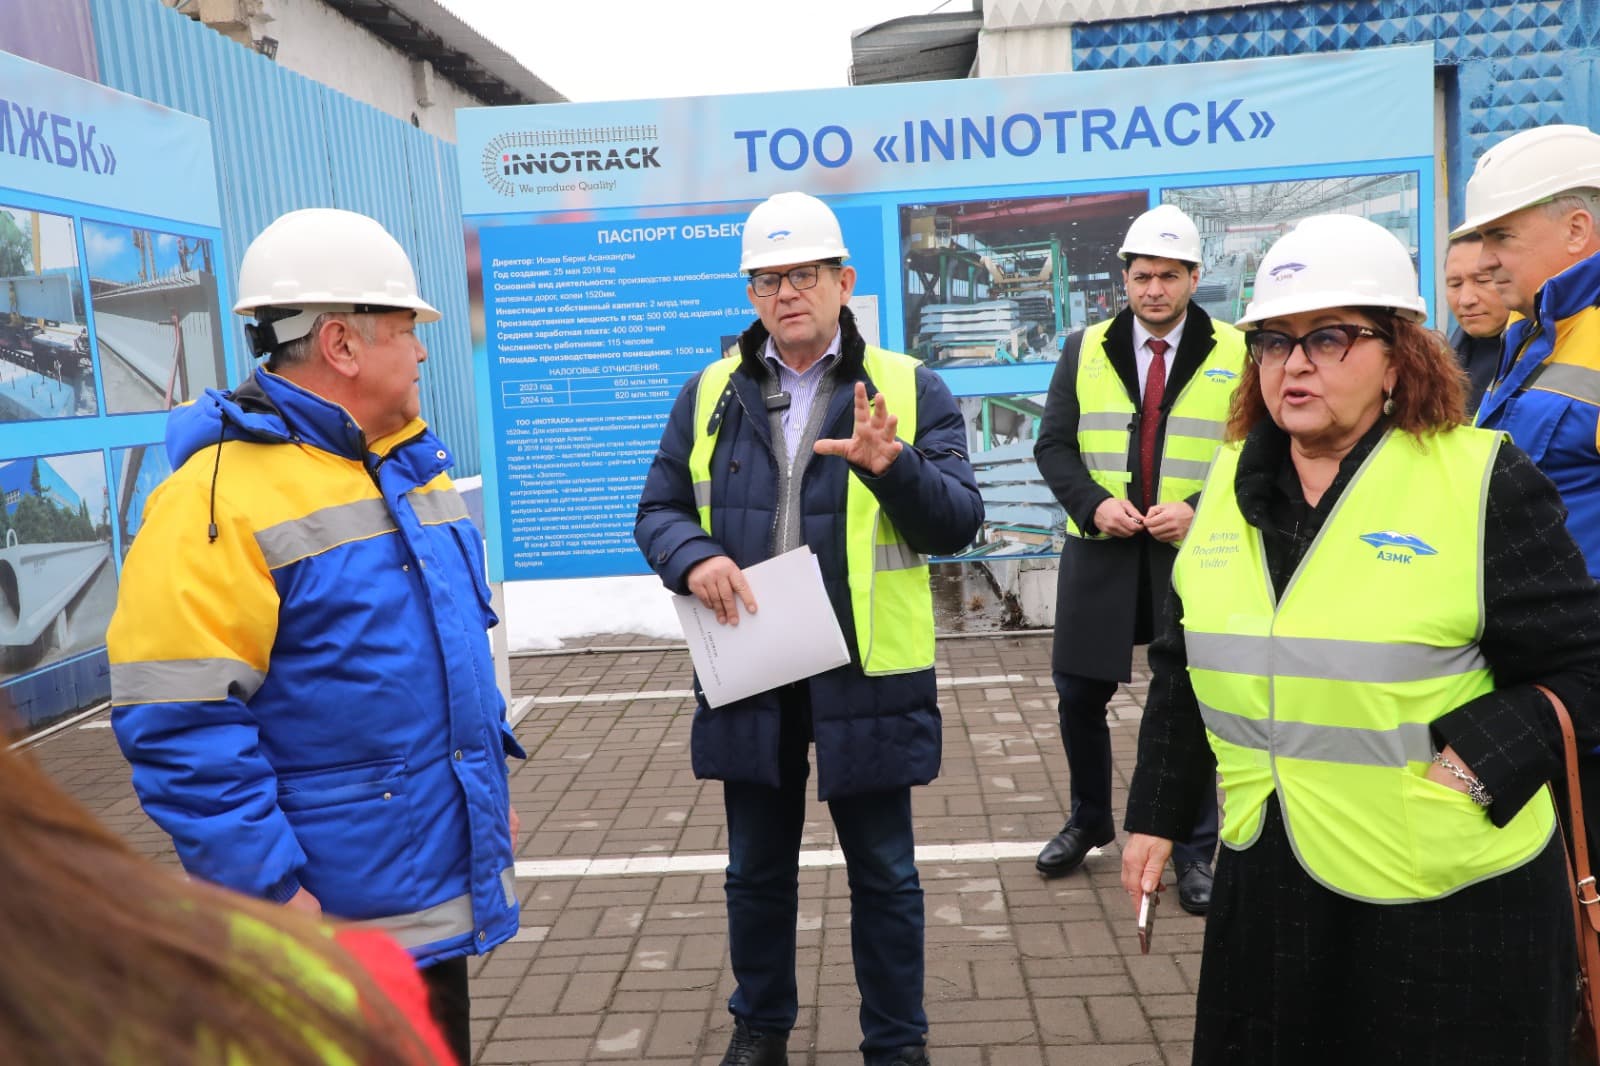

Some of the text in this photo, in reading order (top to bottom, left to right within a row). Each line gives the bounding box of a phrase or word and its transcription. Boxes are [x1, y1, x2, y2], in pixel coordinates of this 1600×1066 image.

[734, 98, 1276, 173] ТОО «INNOTRACK»
[519, 179, 617, 195] We produce Quality!
[597, 226, 678, 245] ПАСПОРТ
[492, 258, 534, 267] Директор:
[494, 270, 508, 279] Год
[511, 269, 552, 278] создания:
[603, 266, 616, 274] год
[494, 282, 536, 290] Основной
[538, 281, 554, 289] вид
[556, 279, 616, 288] деятельности:
[619, 276, 672, 285] производство
[496, 306, 546, 316] Инвестиции
[555, 303, 610, 312] собственный
[612, 301, 648, 309] капитал:
[497, 317, 575, 329] Производственная
[577, 315, 619, 324] мощность
[628, 313, 644, 322] год:
[647, 312, 661, 320] 500
[497, 331, 533, 340] Средняя
[536, 329, 582, 338] заработная
[584, 327, 610, 335] плата:
[498, 343, 552, 351] Численность
[499, 356, 537, 365] Площадь
[540, 351, 620, 362] производственного
[623, 348, 672, 358] помещения:
[549, 366, 600, 376] НАЛОГОВЫЕ
[540, 382, 553, 391] год
[1376, 550, 1413, 564] АЗМК
